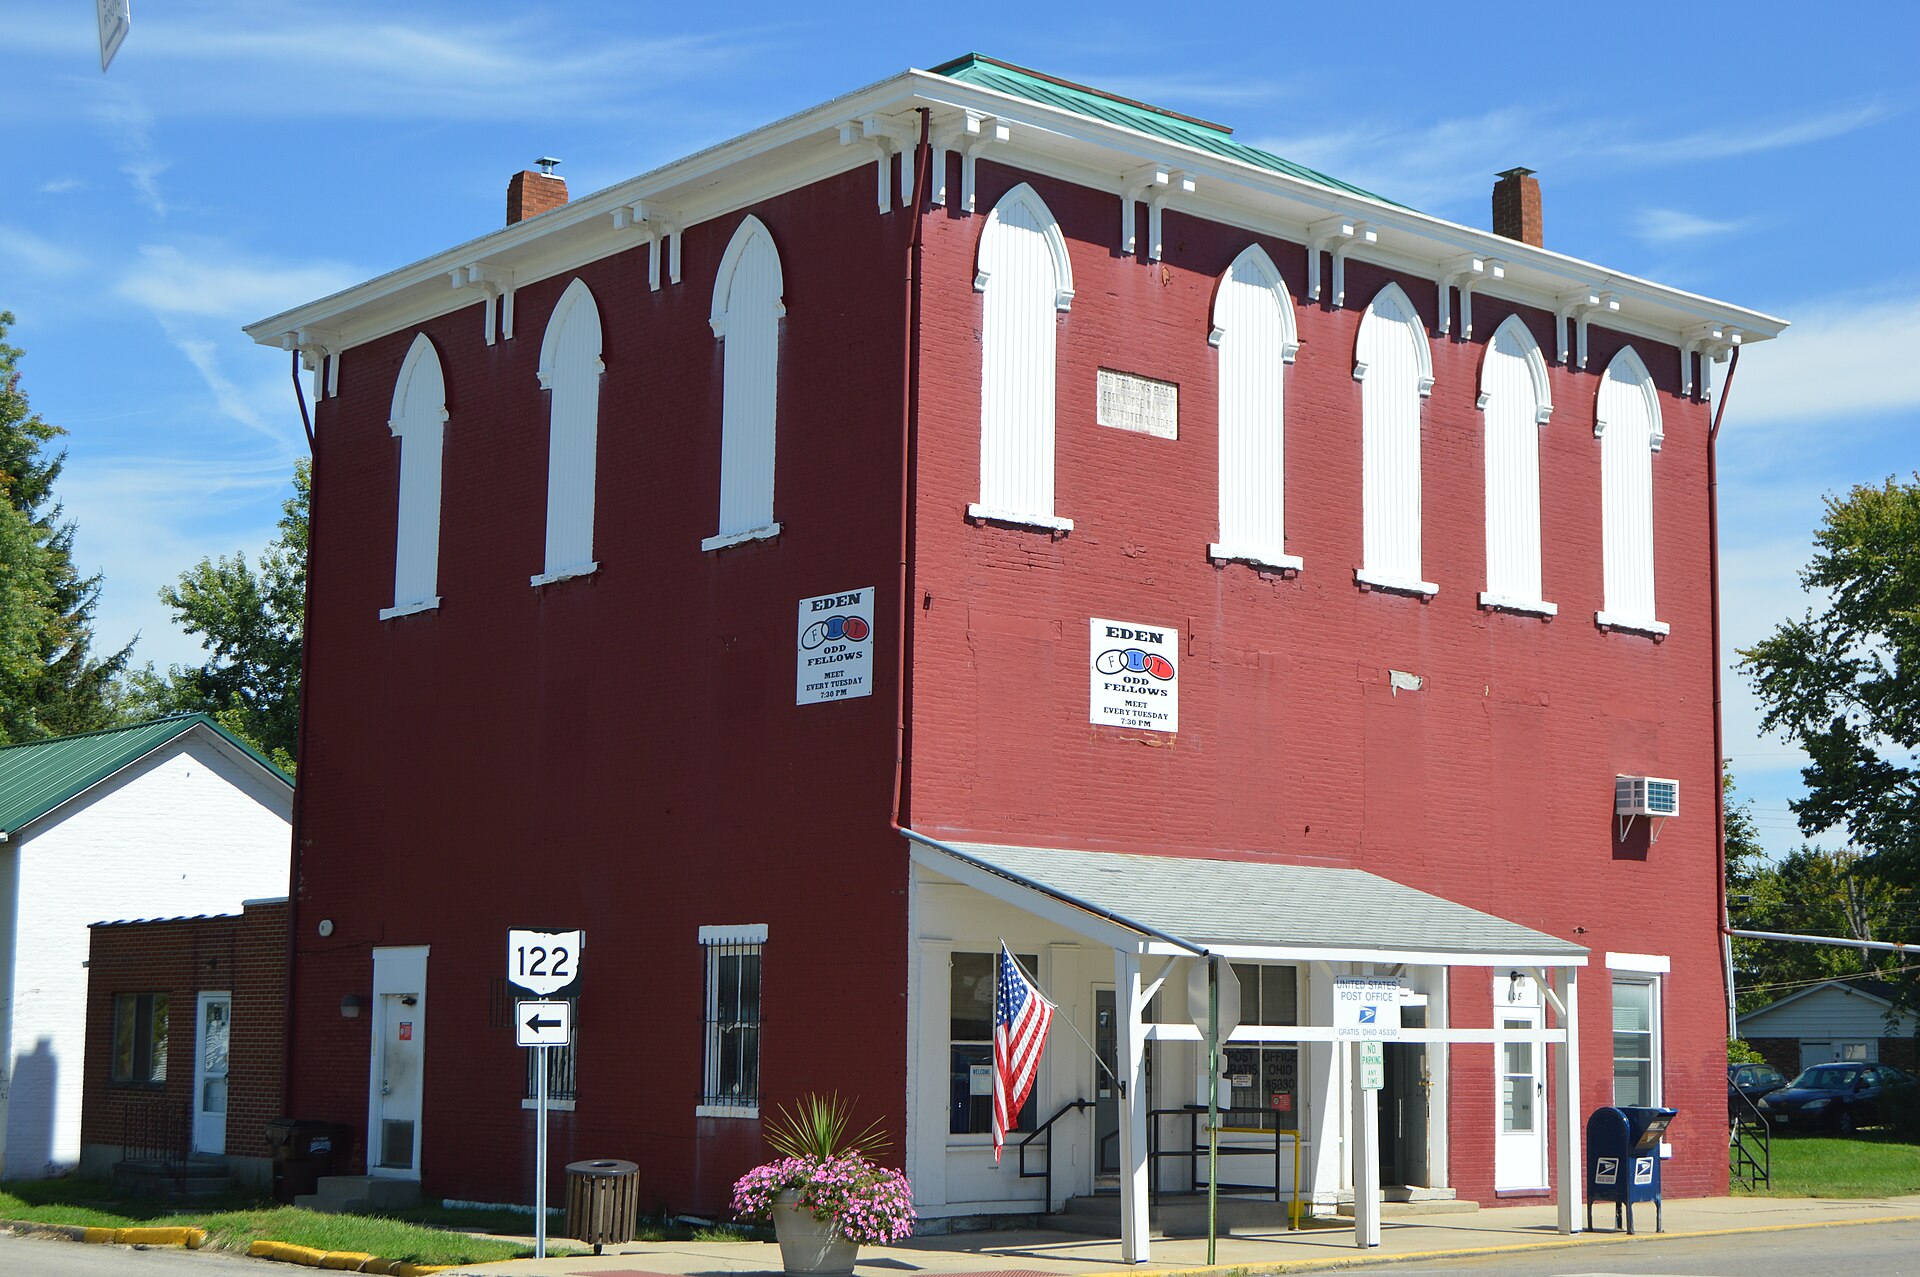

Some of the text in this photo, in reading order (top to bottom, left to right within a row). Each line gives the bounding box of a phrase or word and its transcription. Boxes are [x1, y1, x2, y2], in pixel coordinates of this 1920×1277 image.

[811, 592, 861, 612] EDEN
[811, 629, 818, 642] F
[1105, 626, 1164, 644] EDEN
[824, 644, 846, 654] ODD
[807, 651, 862, 666] FELLOWS
[1108, 654, 1164, 672] F L T
[824, 670, 844, 680] MEET
[806, 677, 863, 692] EVERY TUESDAY
[1123, 676, 1150, 686] ODD
[820, 688, 848, 698] 7:30 PM
[1104, 682, 1168, 696] FELLOWS
[1124, 700, 1148, 708] MEET
[1104, 706, 1168, 720] EVERY TUESDAY
[1120, 718, 1136, 726] 7:30
[518, 946, 569, 976] 122
[1336, 980, 1396, 990] UNITED STATES
[1340, 992, 1393, 1002] POST OFFICE
[1362, 1028, 1378, 1036] OHIO
[1368, 1044, 1376, 1054] NO
[1228, 1050, 1298, 1062] POST OFFICE
[1362, 1056, 1382, 1064] PARKING
[1268, 1064, 1293, 1076] OHIO
